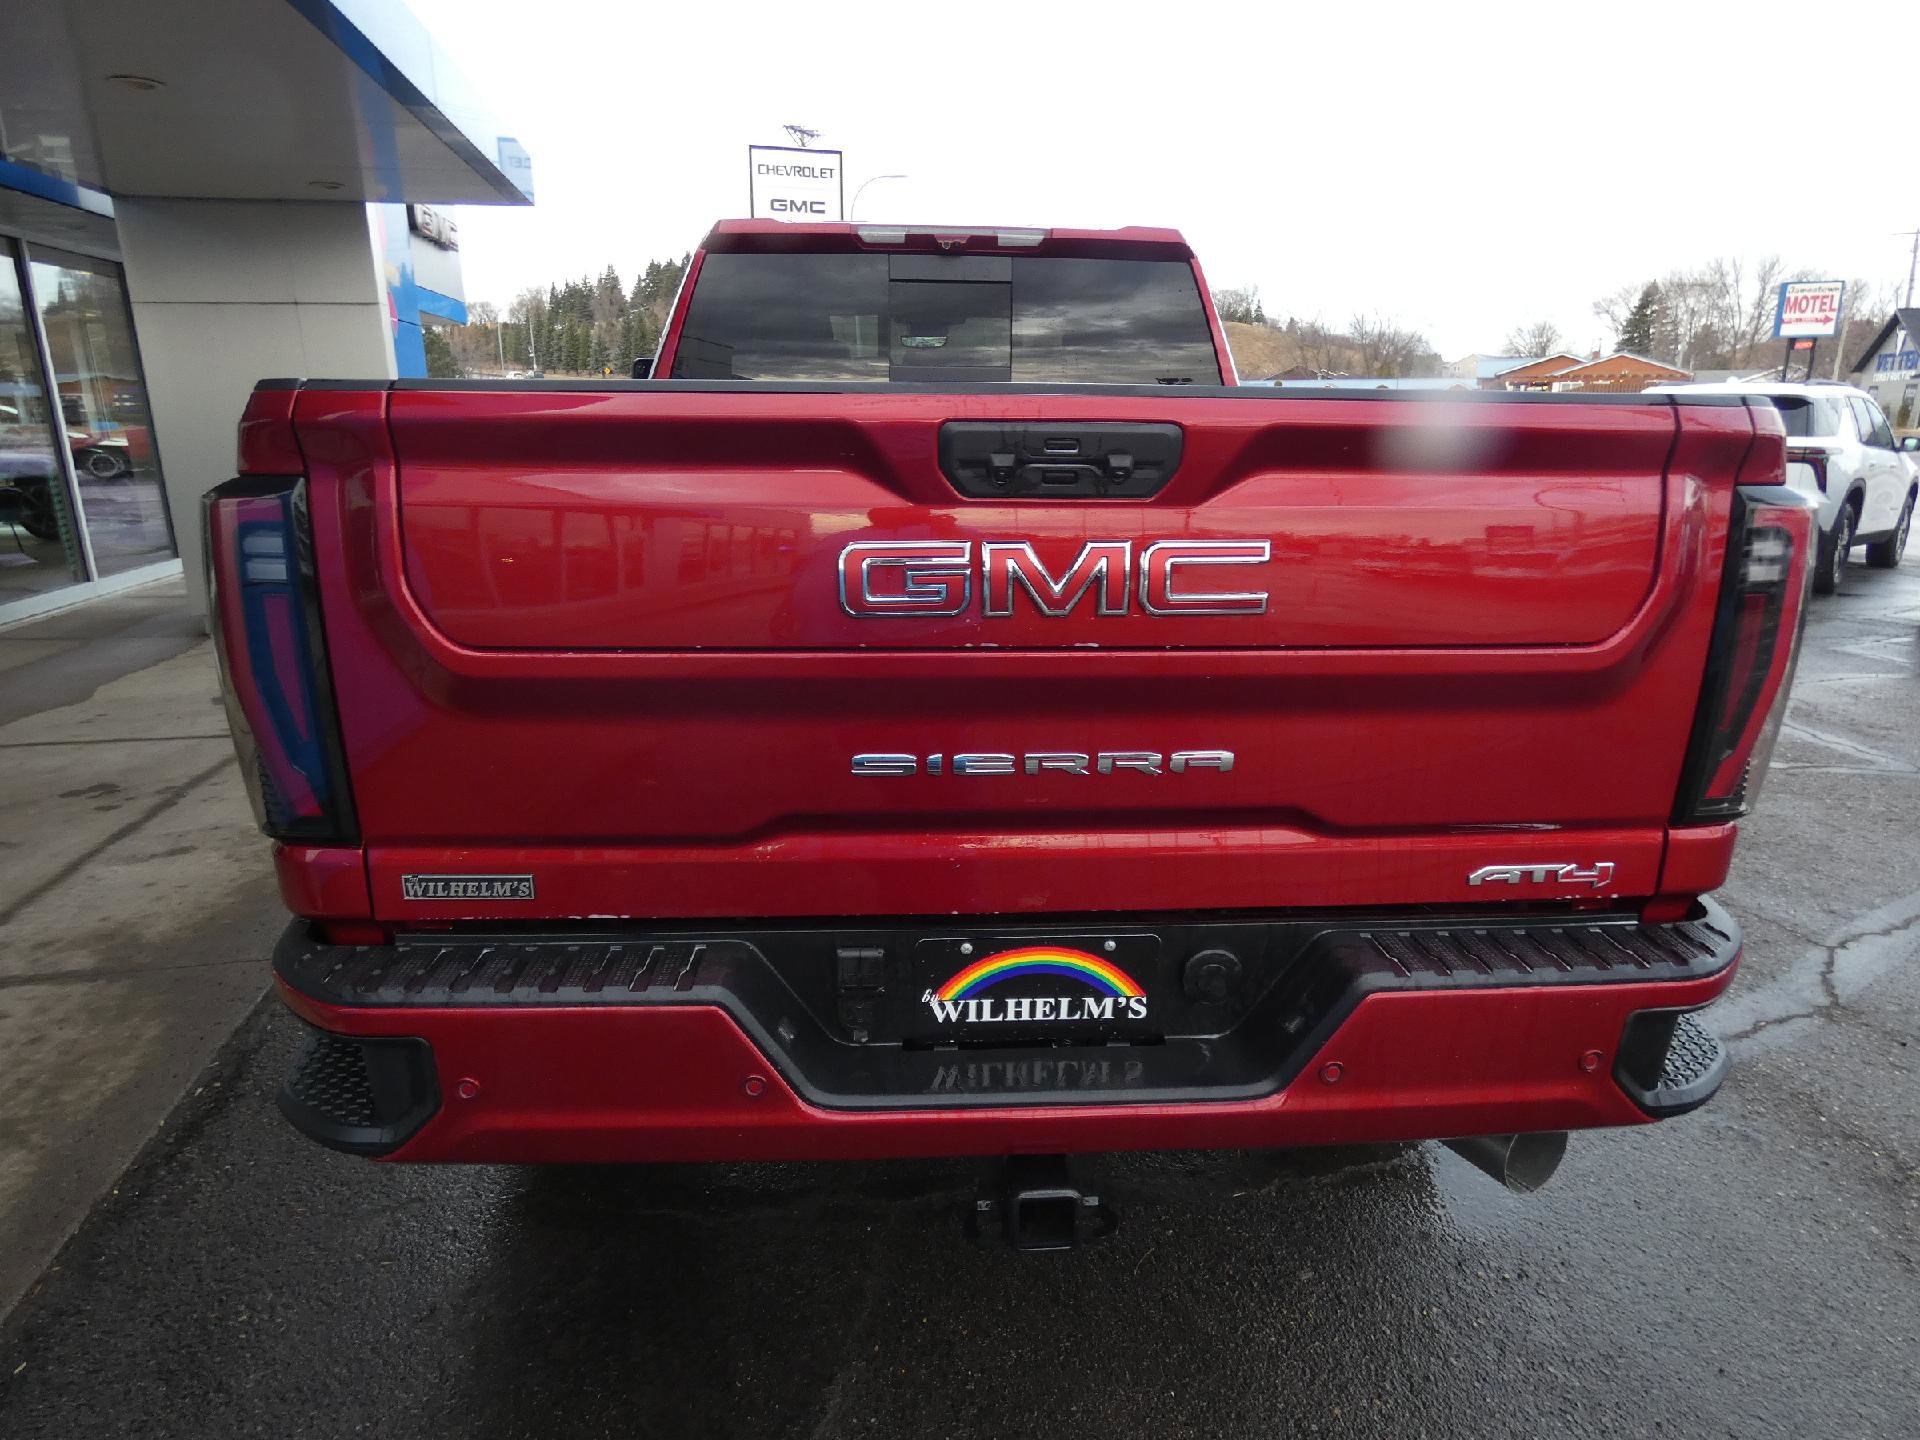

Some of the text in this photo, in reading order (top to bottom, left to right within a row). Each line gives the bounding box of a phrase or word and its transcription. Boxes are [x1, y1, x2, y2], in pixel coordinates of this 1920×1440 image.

[757, 164, 835, 179] CHEVROLET
[770, 198, 826, 214] GMC
[1784, 294, 1837, 314] MOTEL
[837, 539, 1272, 618] GMC
[851, 749, 1236, 777] SIERRA
[1468, 862, 1616, 889] AT4
[405, 881, 530, 897] WILHELM'S
[930, 995, 1148, 1023] WILHELM'S
